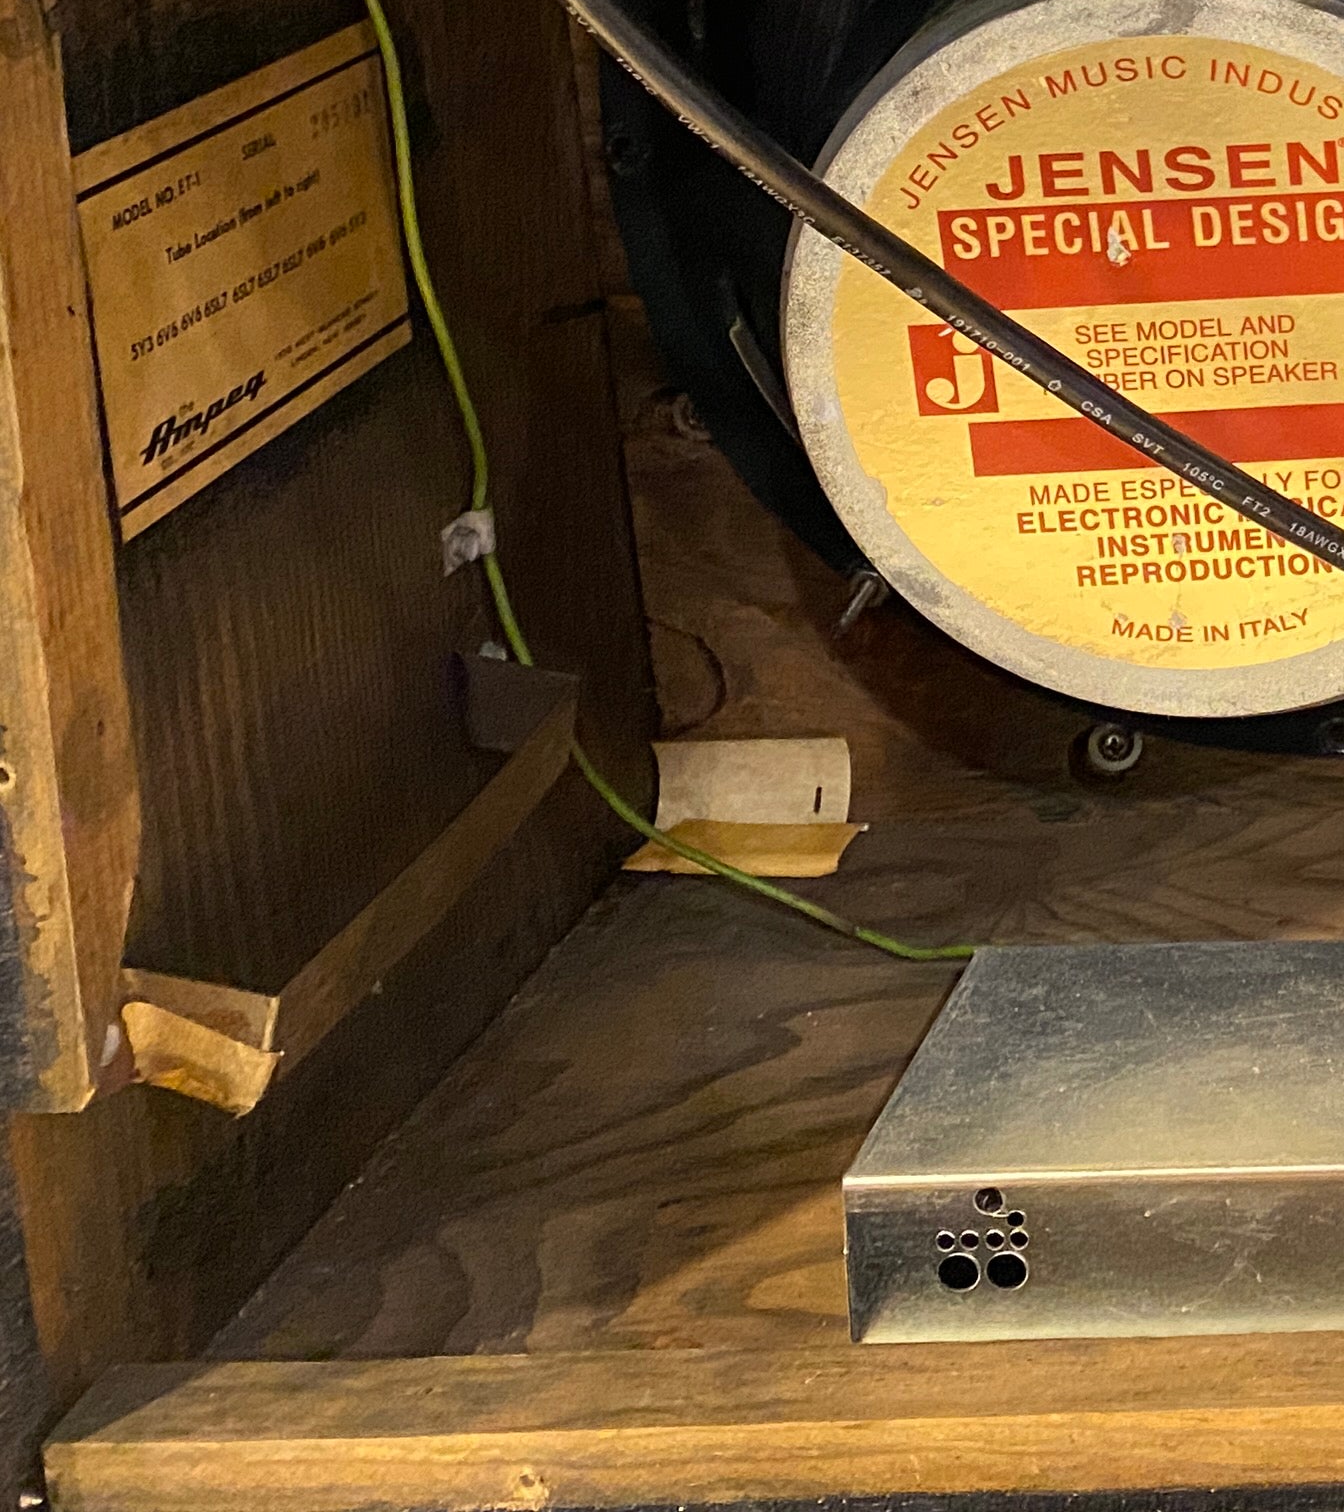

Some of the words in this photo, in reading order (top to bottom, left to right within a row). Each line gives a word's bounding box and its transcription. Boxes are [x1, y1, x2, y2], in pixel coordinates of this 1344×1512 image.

[902, 88, 1032, 211] JENSEN
[1043, 54, 1188, 99] MUSIC
[113, 197, 152, 231] MODEL
[165, 242, 192, 265] Tube
[194, 215, 238, 249] Location
[951, 209, 1170, 261] SPECIAL
[130, 334, 155, 361] 5Y3
[156, 322, 179, 348] 6V6
[181, 306, 203, 332] 6V6
[204, 291, 228, 319] 6SL7
[232, 278, 257, 304] 6SL7
[257, 263, 281, 289] 6SL7
[1074, 322, 1127, 346] SEE
[1133, 317, 1221, 344] MODEL
[1237, 314, 1296, 338] AND
[1086, 339, 1290, 368] SPECIFICATION
[1166, 365, 1204, 391] ON
[1206, 360, 1338, 390] SPEAKER
[140, 369, 267, 466] Ampeg
[945, 313, 1032, 374] 191710-001
[1080, 399, 1114, 427] CSA
[1131, 432, 1166, 456] SVT
[1181, 461, 1226, 492] 105°C
[1241, 495, 1272, 519] FT2
[1028, 480, 1111, 507] MADE
[1016, 501, 1225, 535] ELECTRONIC
[1097, 527, 1287, 559] INSTRUMEN
[1076, 556, 1334, 588] REPRODUCTION
[1111, 617, 1194, 643] MADE
[1202, 620, 1231, 643] IN
[1238, 608, 1311, 640] ITALY
